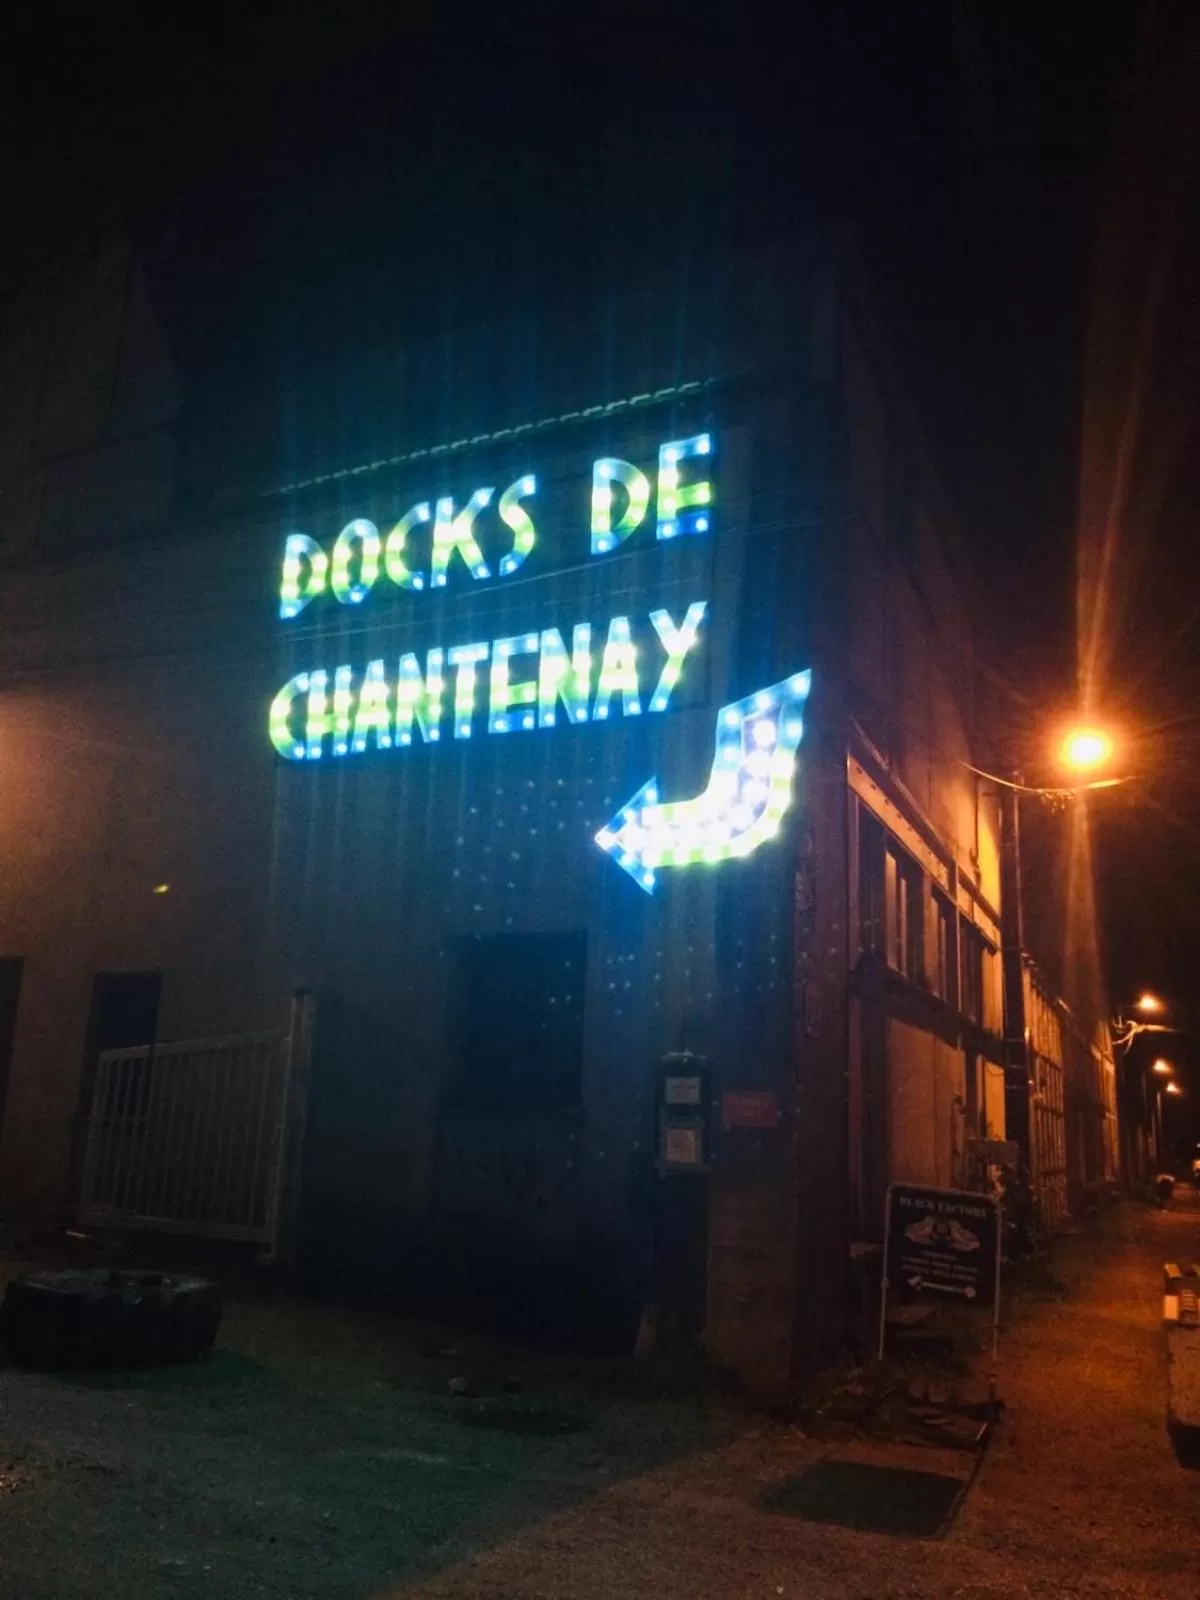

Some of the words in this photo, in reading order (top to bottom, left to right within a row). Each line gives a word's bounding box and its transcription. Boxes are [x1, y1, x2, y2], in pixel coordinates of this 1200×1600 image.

[279, 472, 536, 619] DOCKS
[590, 433, 712, 555] DE
[269, 601, 708, 761] CHANTENAY
